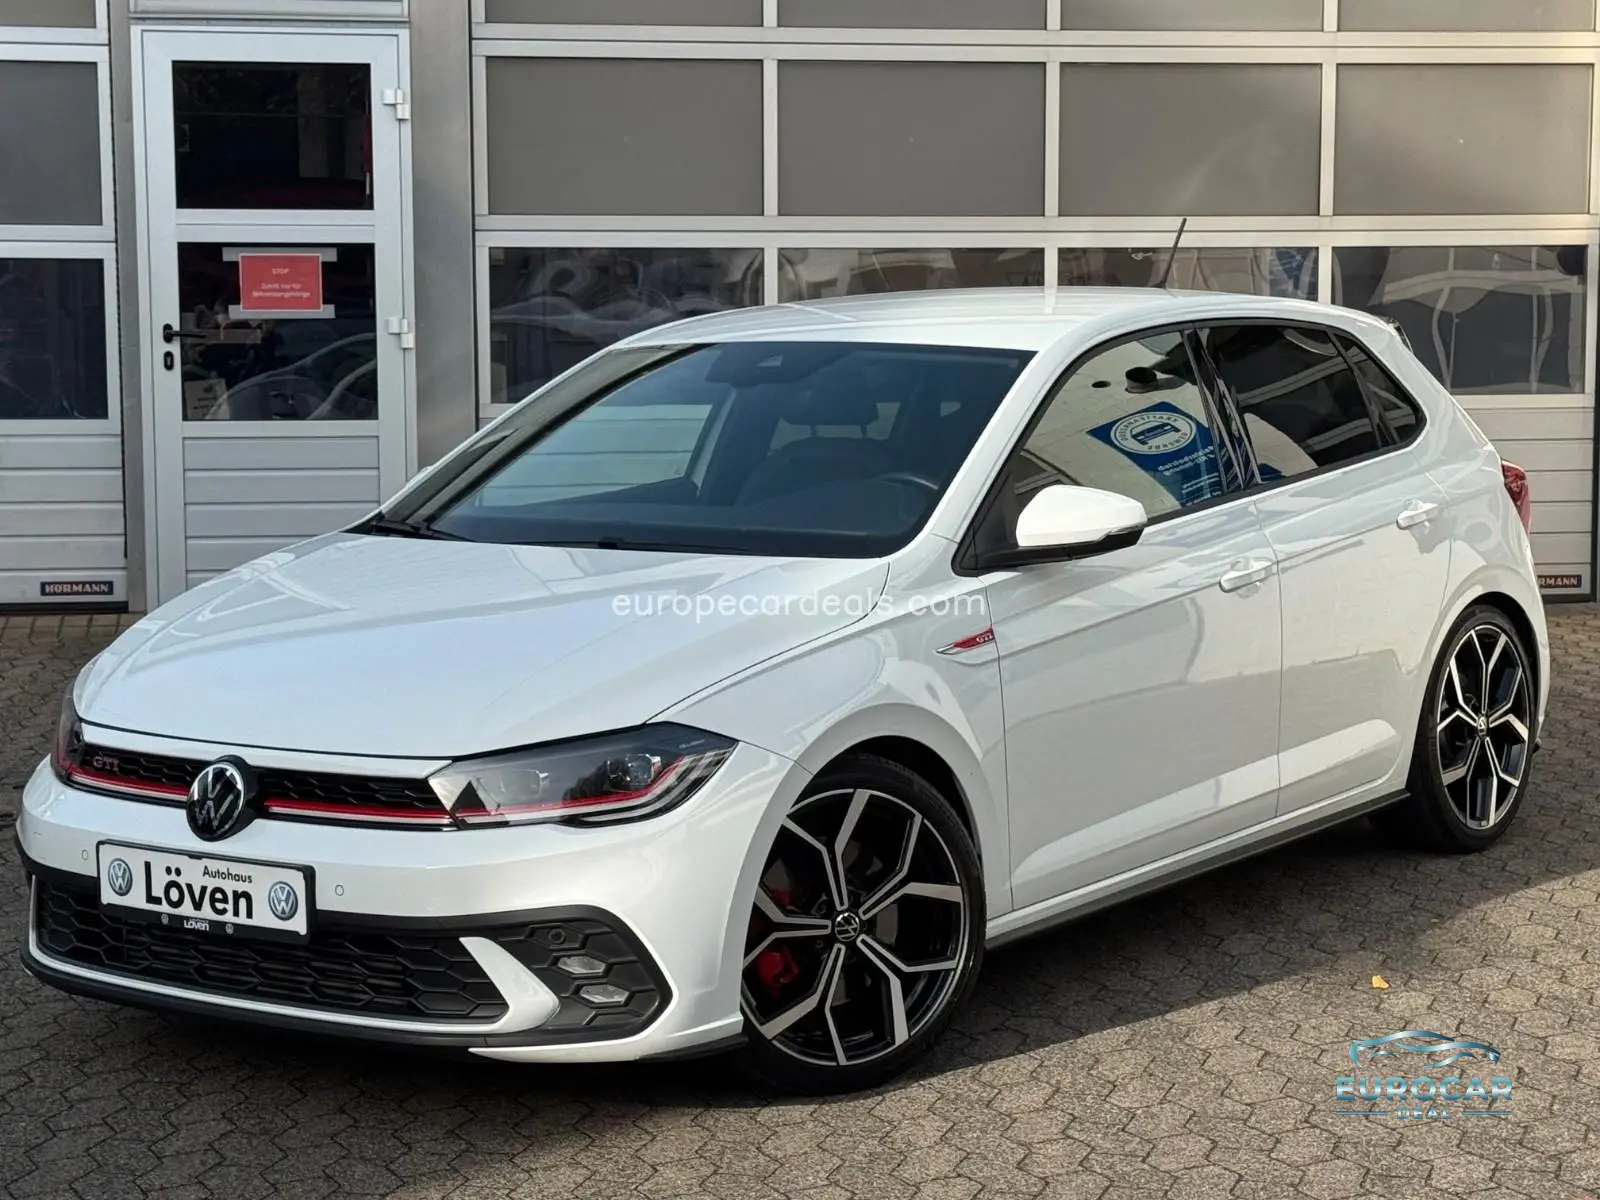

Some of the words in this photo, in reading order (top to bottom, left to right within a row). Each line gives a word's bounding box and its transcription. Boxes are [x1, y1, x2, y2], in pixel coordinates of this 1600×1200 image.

[92, 755, 120, 772] GTI
[202, 864, 253, 884] Autohaus
[144, 860, 254, 920] Löven
